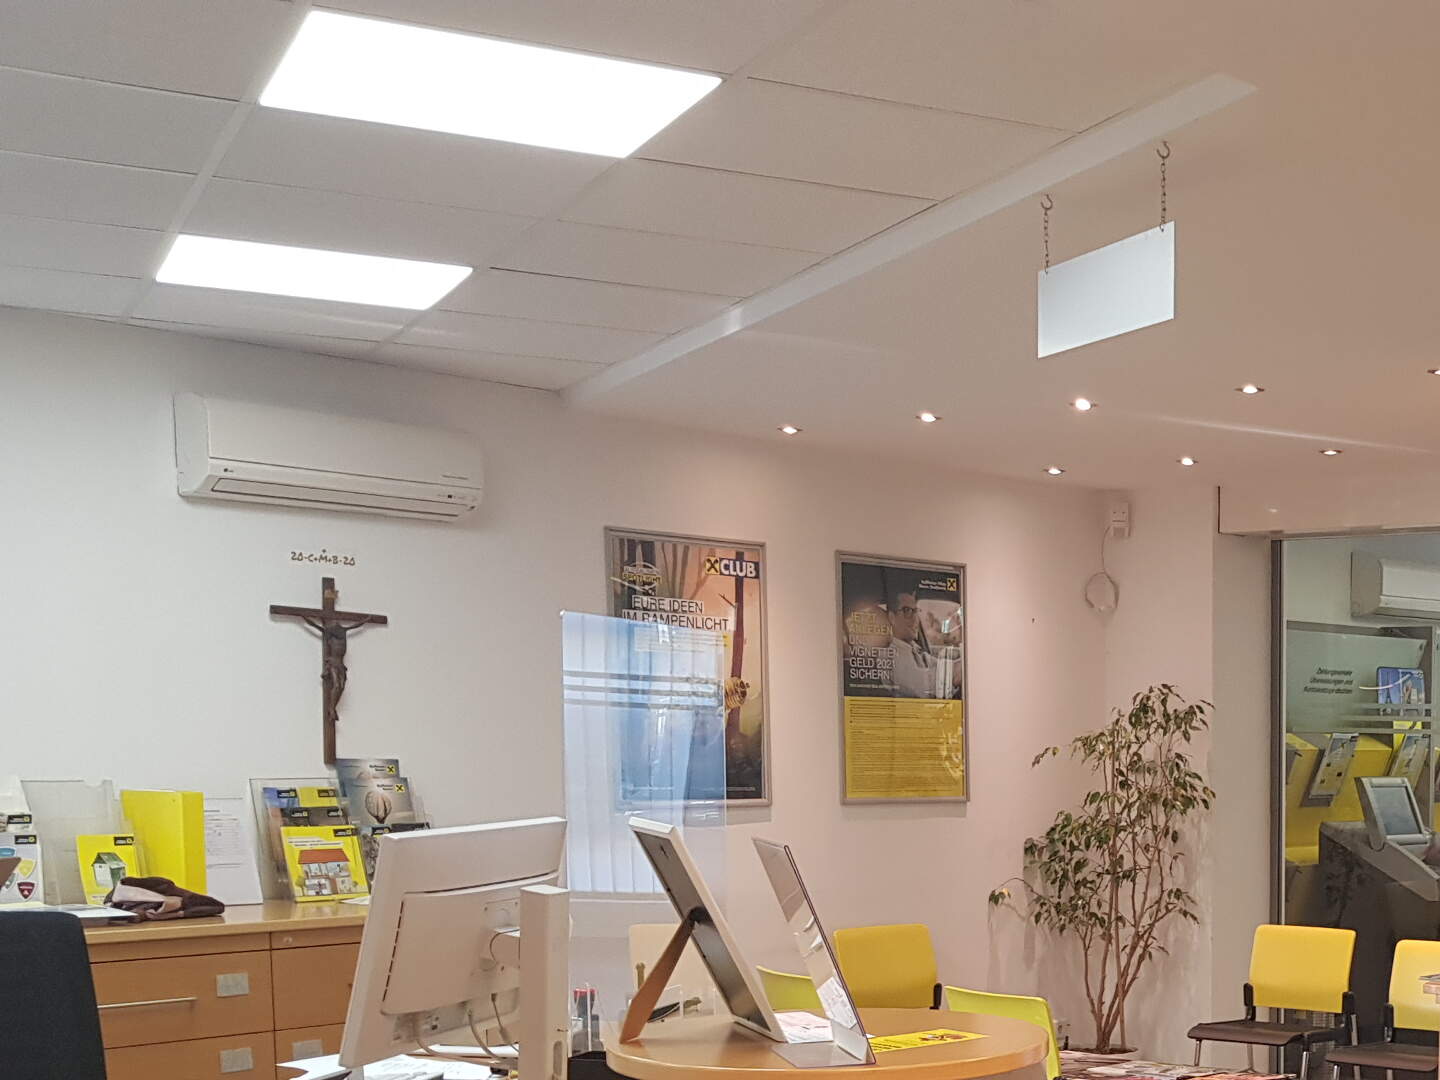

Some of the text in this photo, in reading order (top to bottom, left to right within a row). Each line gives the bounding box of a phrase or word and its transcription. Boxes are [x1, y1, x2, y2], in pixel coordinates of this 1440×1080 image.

[720, 559, 757, 577] CLUB
[633, 596, 703, 615] EURE IDEEN
[623, 610, 730, 631] IM RAMPENLICHT
[849, 657, 875, 668] GELD
[849, 668, 890, 680] SICHERN
